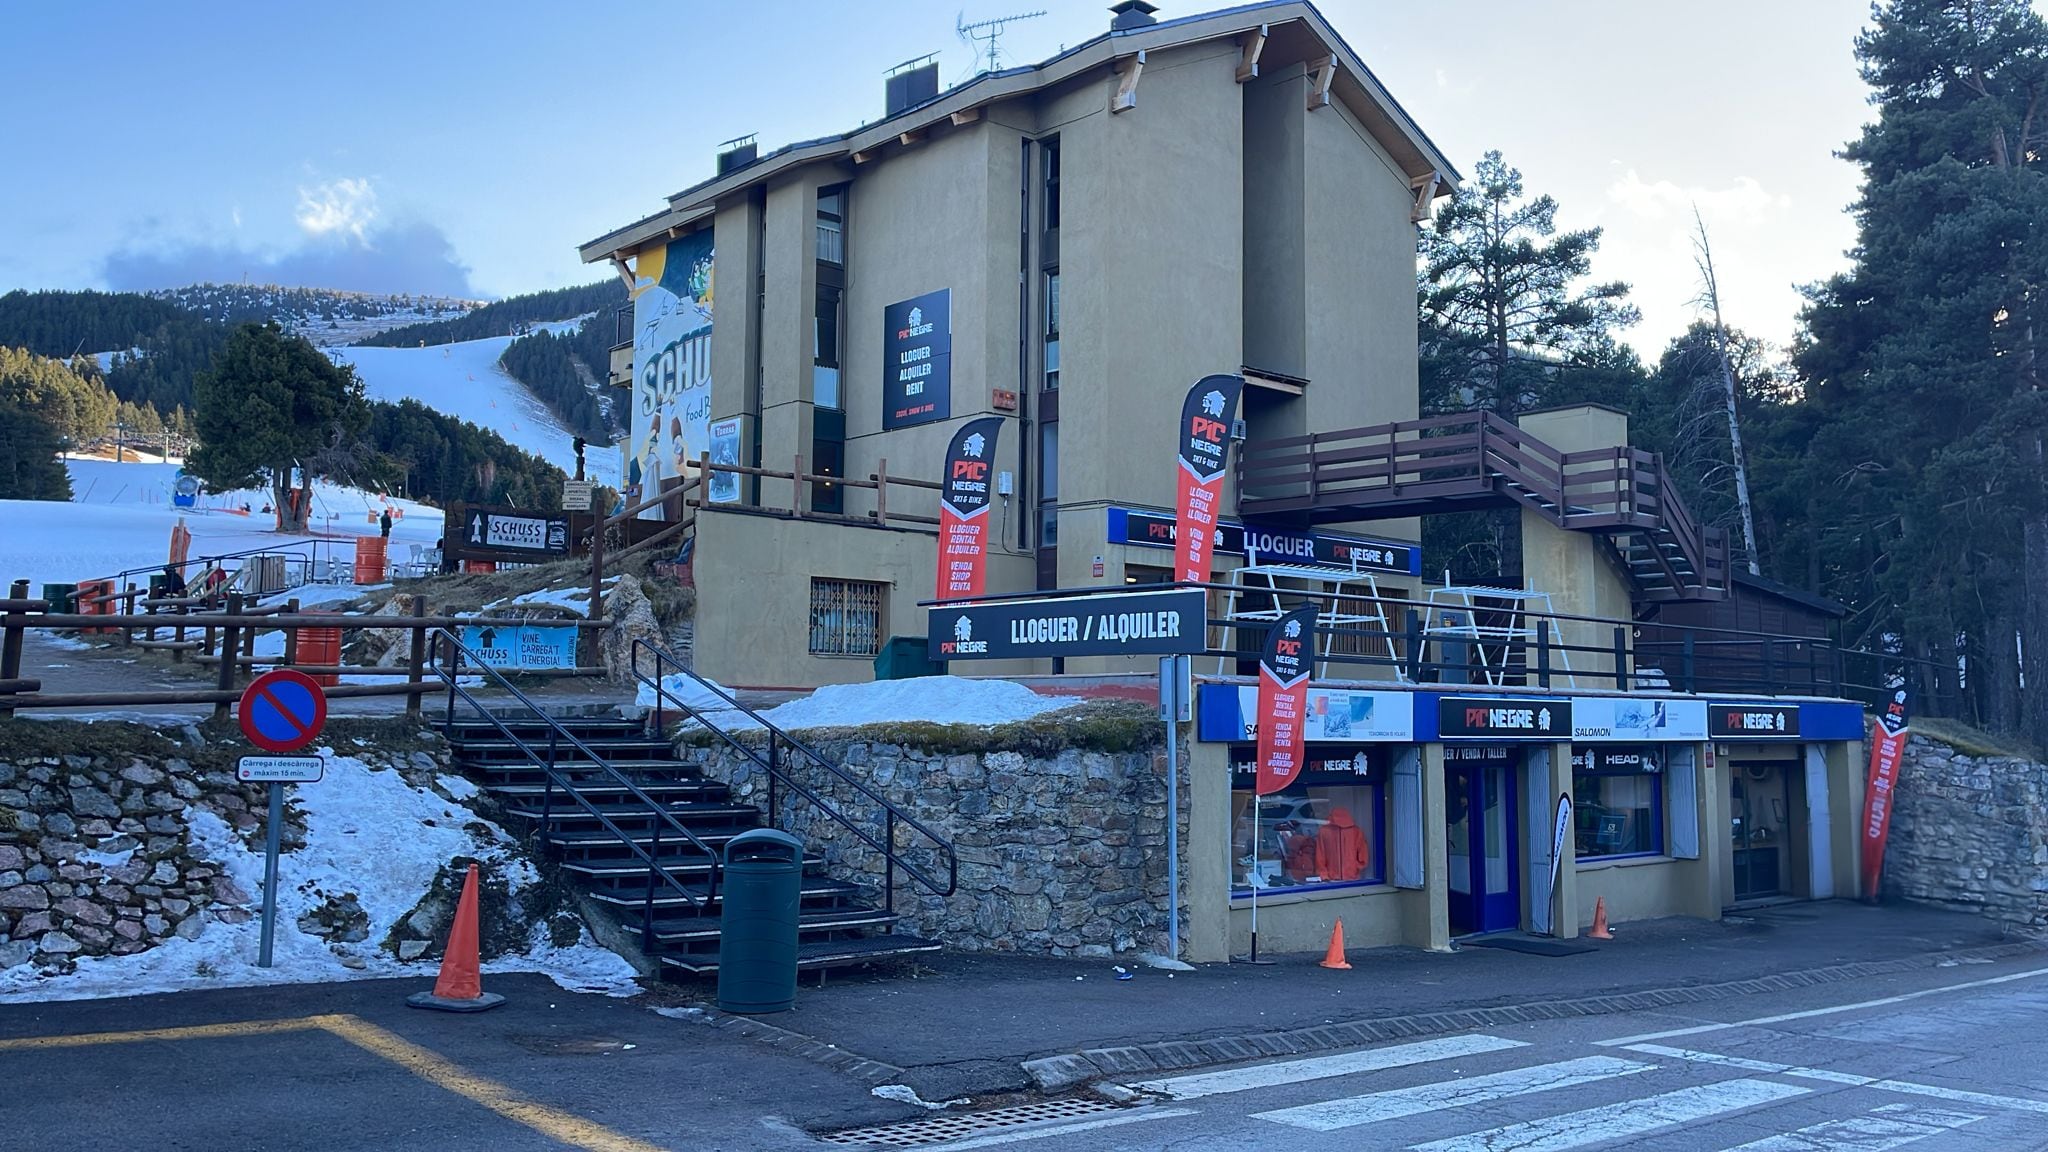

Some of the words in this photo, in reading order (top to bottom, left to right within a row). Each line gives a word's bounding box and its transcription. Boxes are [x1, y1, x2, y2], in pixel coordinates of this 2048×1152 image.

[909, 322, 934, 337] NEGRE
[901, 346, 931, 364] LLOGUER
[899, 363, 932, 382] ALQUILER
[906, 381, 924, 396] RENT
[1190, 437, 1222, 457] NEGRE
[952, 480, 986, 493] NEGRE
[952, 495, 963, 503] SKI
[968, 496, 983, 504] BIKE
[492, 521, 541, 537] SCHUSS
[949, 524, 981, 534] LLOGUER
[951, 534, 976, 545] RENTAL
[1243, 532, 1315, 558] LLOGUER
[947, 545, 980, 555] ALQUILER
[1350, 547, 1382, 563] NEGRE
[950, 561, 973, 571] VENDA
[951, 571, 971, 581] SHOP
[950, 582, 971, 591] VENTA
[1011, 616, 1078, 644] LLOGUER
[1082, 615, 1093, 641] /
[1097, 611, 1180, 643] ALQUILER
[521, 644, 560, 655] CARREGA'T
[956, 640, 988, 653] NEGRE
[470, 648, 508, 660] CHUSS
[521, 655, 560, 666] D'ENERGIA!
[1275, 654, 1300, 666] NEGRE
[1489, 708, 1534, 728] NEGRE
[1743, 713, 1773, 730] NEGRE
[1275, 731, 1291, 739] SHOP
[1574, 727, 1611, 737] SALOMON
[1272, 751, 1292, 760] TALLER
[1461, 748, 1480, 759] VENDA
[1487, 748, 1507, 759] TALLER
[1606, 755, 1639, 764] HEAD
[1324, 760, 1351, 771] NEGRE
